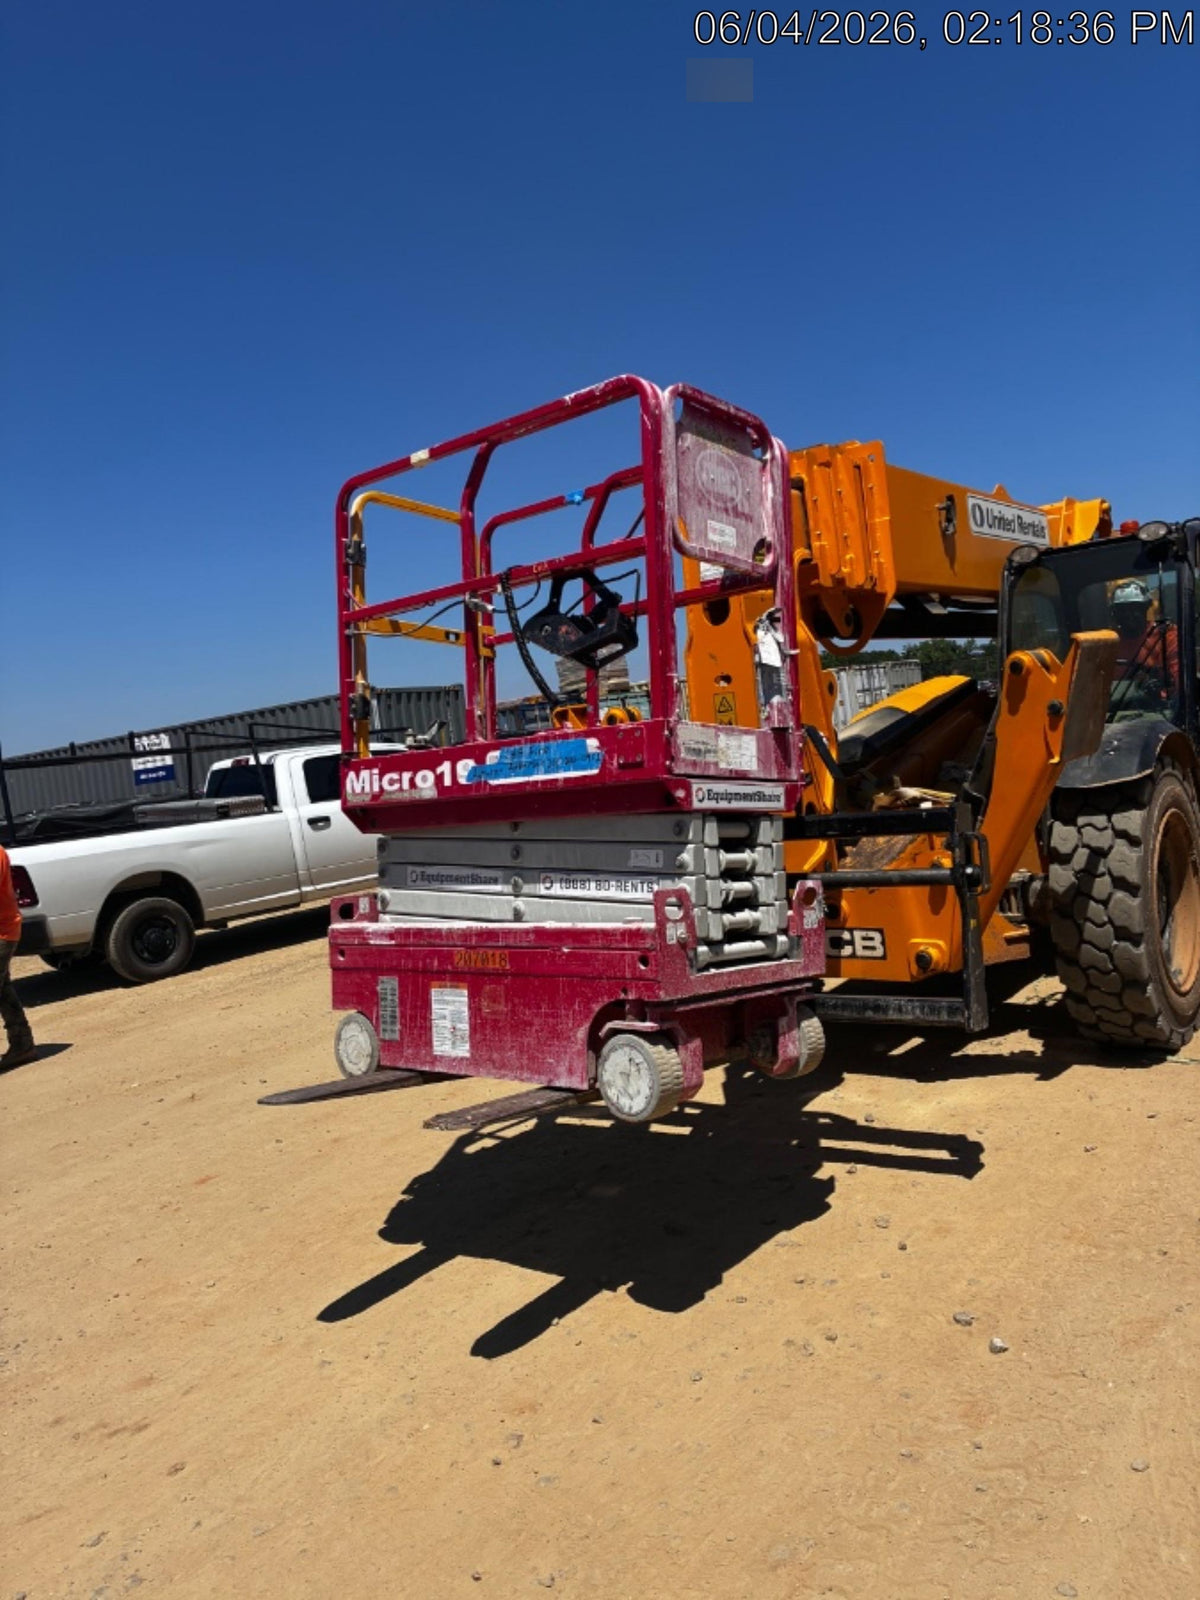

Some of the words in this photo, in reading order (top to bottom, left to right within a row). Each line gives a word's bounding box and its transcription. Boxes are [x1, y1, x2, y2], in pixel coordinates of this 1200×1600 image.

[986, 507, 1015, 533] United
[1017, 514, 1046, 539] Rentals
[706, 789, 782, 804] EquipmentShare
[420, 870, 499, 885] EquipmentShare
[825, 929, 885, 957] CB
